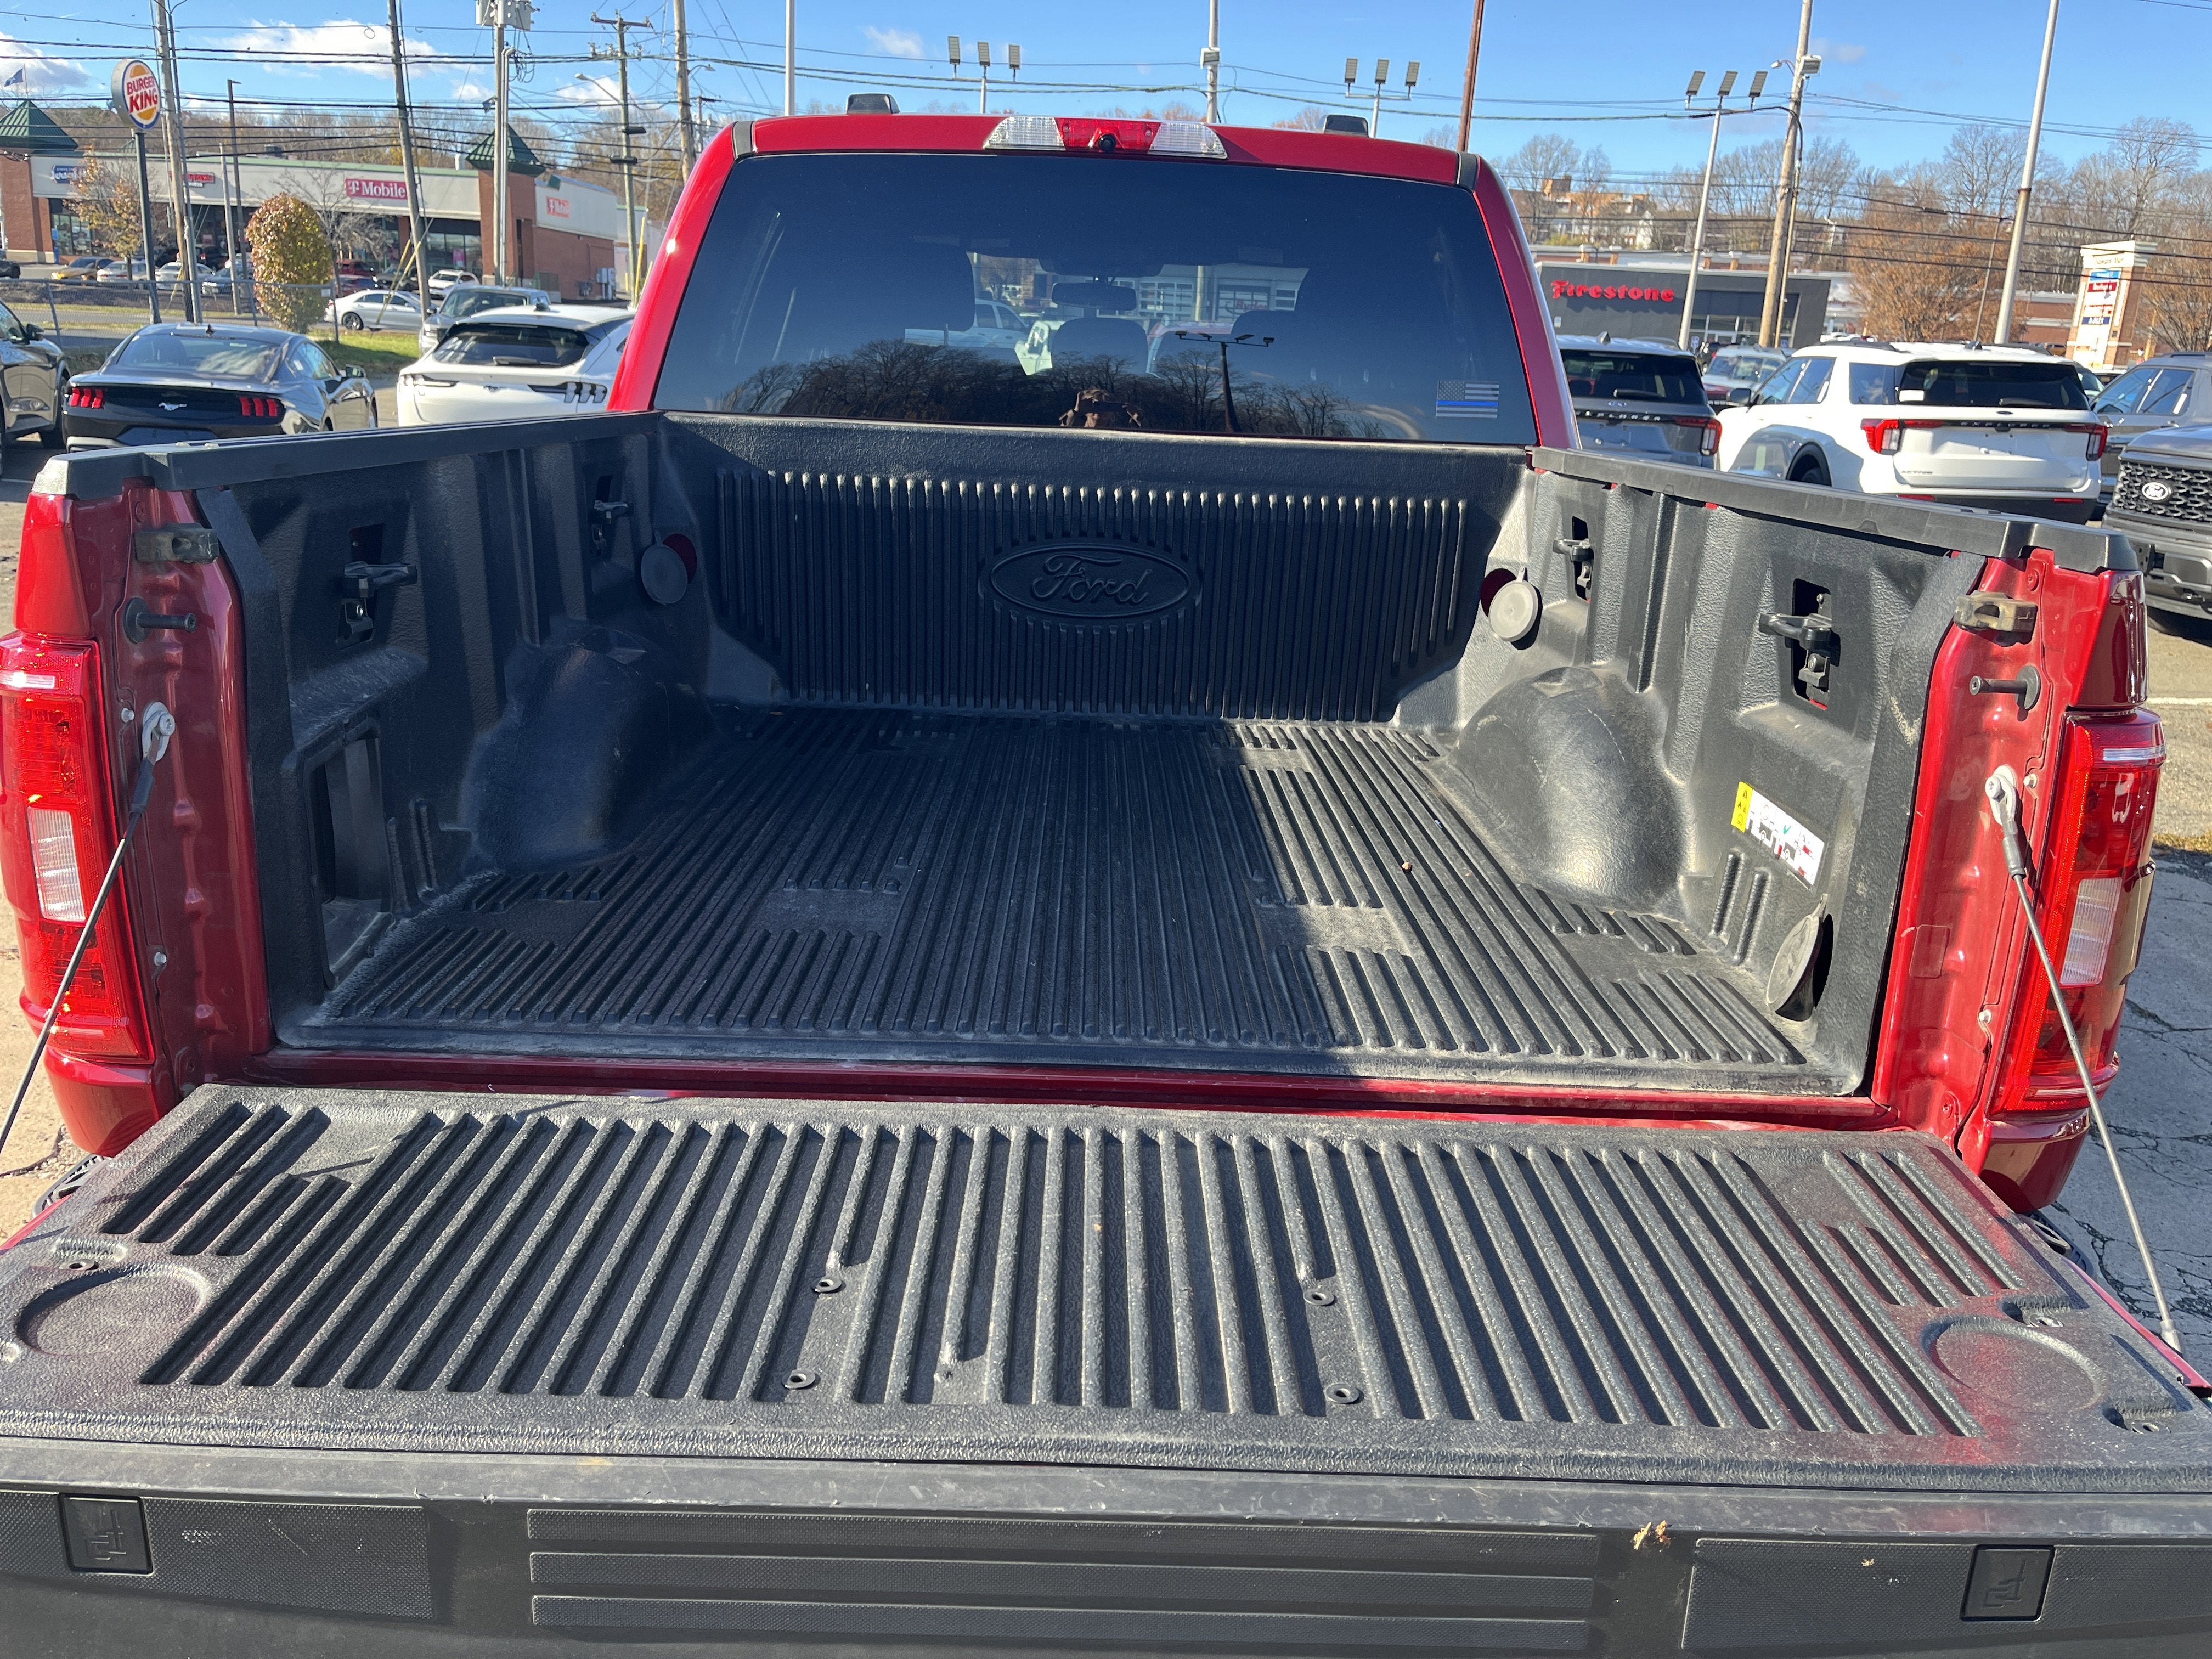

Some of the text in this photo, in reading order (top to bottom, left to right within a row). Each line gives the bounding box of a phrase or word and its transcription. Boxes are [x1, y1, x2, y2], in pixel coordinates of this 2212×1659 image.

[126, 76, 156, 95] BURGER
[129, 88, 158, 113] KING
[1551, 279, 1675, 302] Firestone
[1030, 552, 1152, 603] Ford
